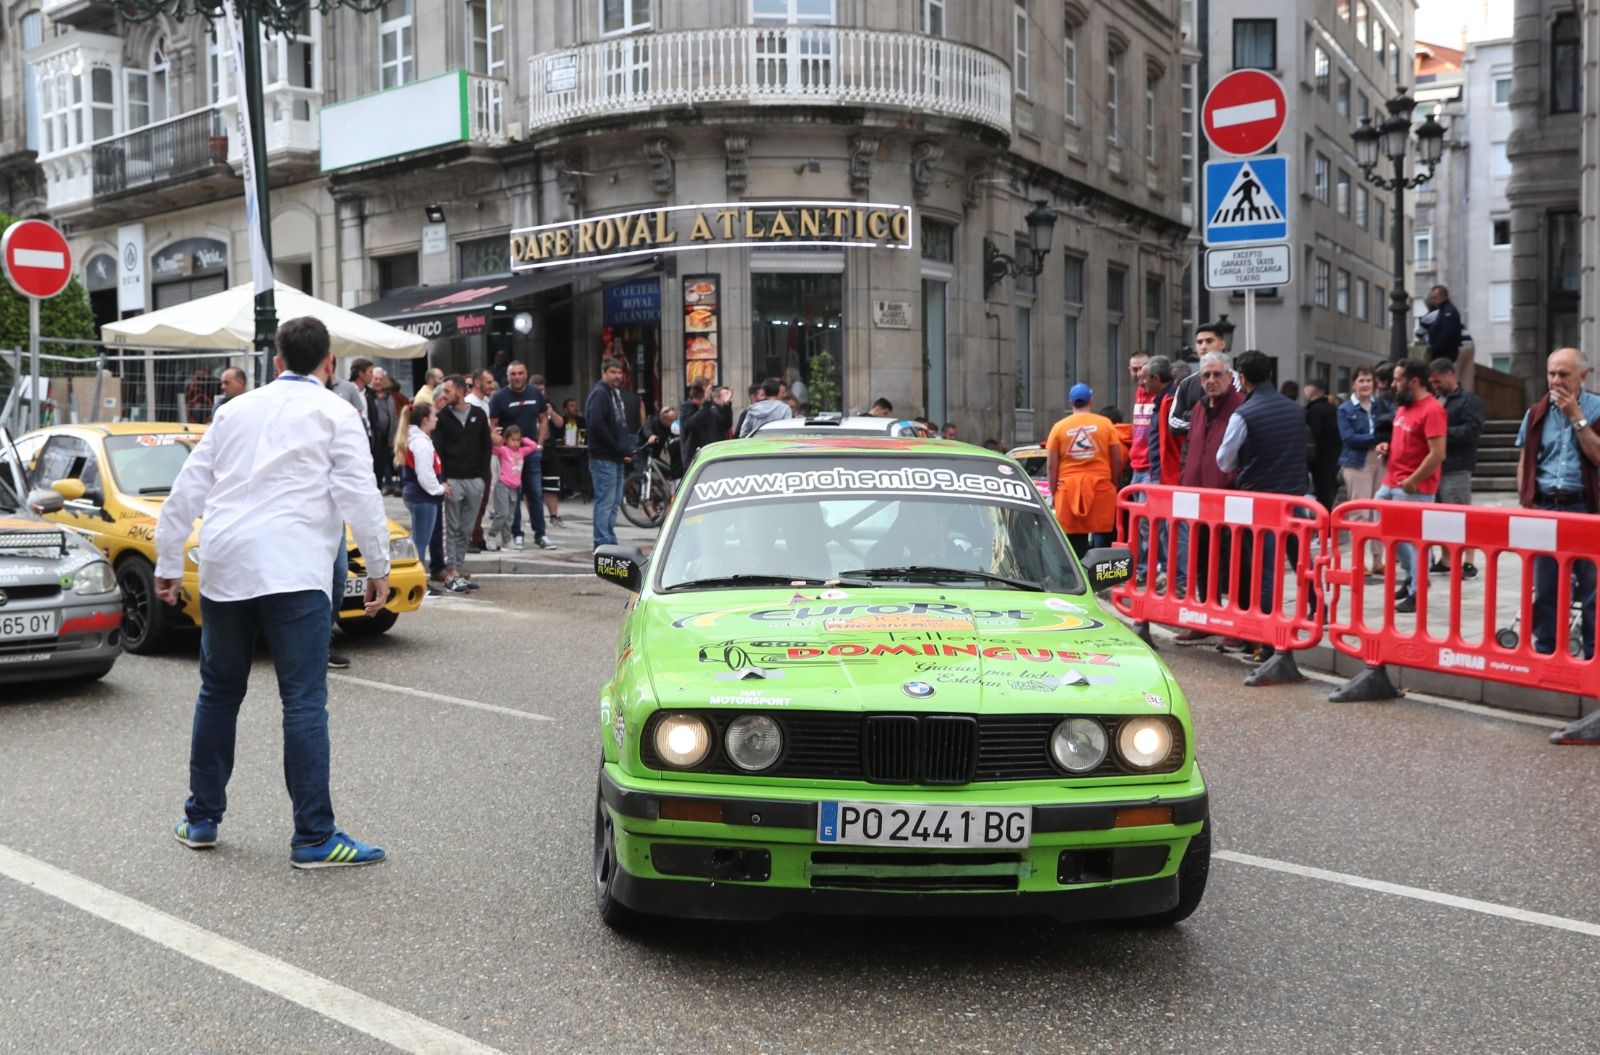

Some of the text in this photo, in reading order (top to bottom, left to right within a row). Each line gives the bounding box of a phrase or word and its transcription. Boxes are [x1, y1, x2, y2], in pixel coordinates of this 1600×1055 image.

[511, 208, 909, 262] CAFE ROYAL ATLANTICO
[1233, 251, 1263, 259] EXCEPTO
[1220, 268, 1241, 276] CARGA
[1246, 265, 1282, 274] DESCARGA
[612, 283, 659, 297] CAFETERI
[623, 297, 653, 309] ROYAL
[694, 467, 1032, 500] www.prohemi09.com
[598, 565, 629, 578] RACING
[1096, 568, 1128, 581] RACING
[0, 617, 24, 634] 65
[787, 643, 1121, 668] DOMINGUEZ
[914, 660, 977, 675] Gracias
[988, 668, 1012, 680] por
[936, 673, 1001, 689] Esteban
[709, 695, 792, 706] MOTORSPORT
[825, 826, 832, 836] E
[889, 808, 971, 843] 2441
[984, 811, 1026, 844] BG
